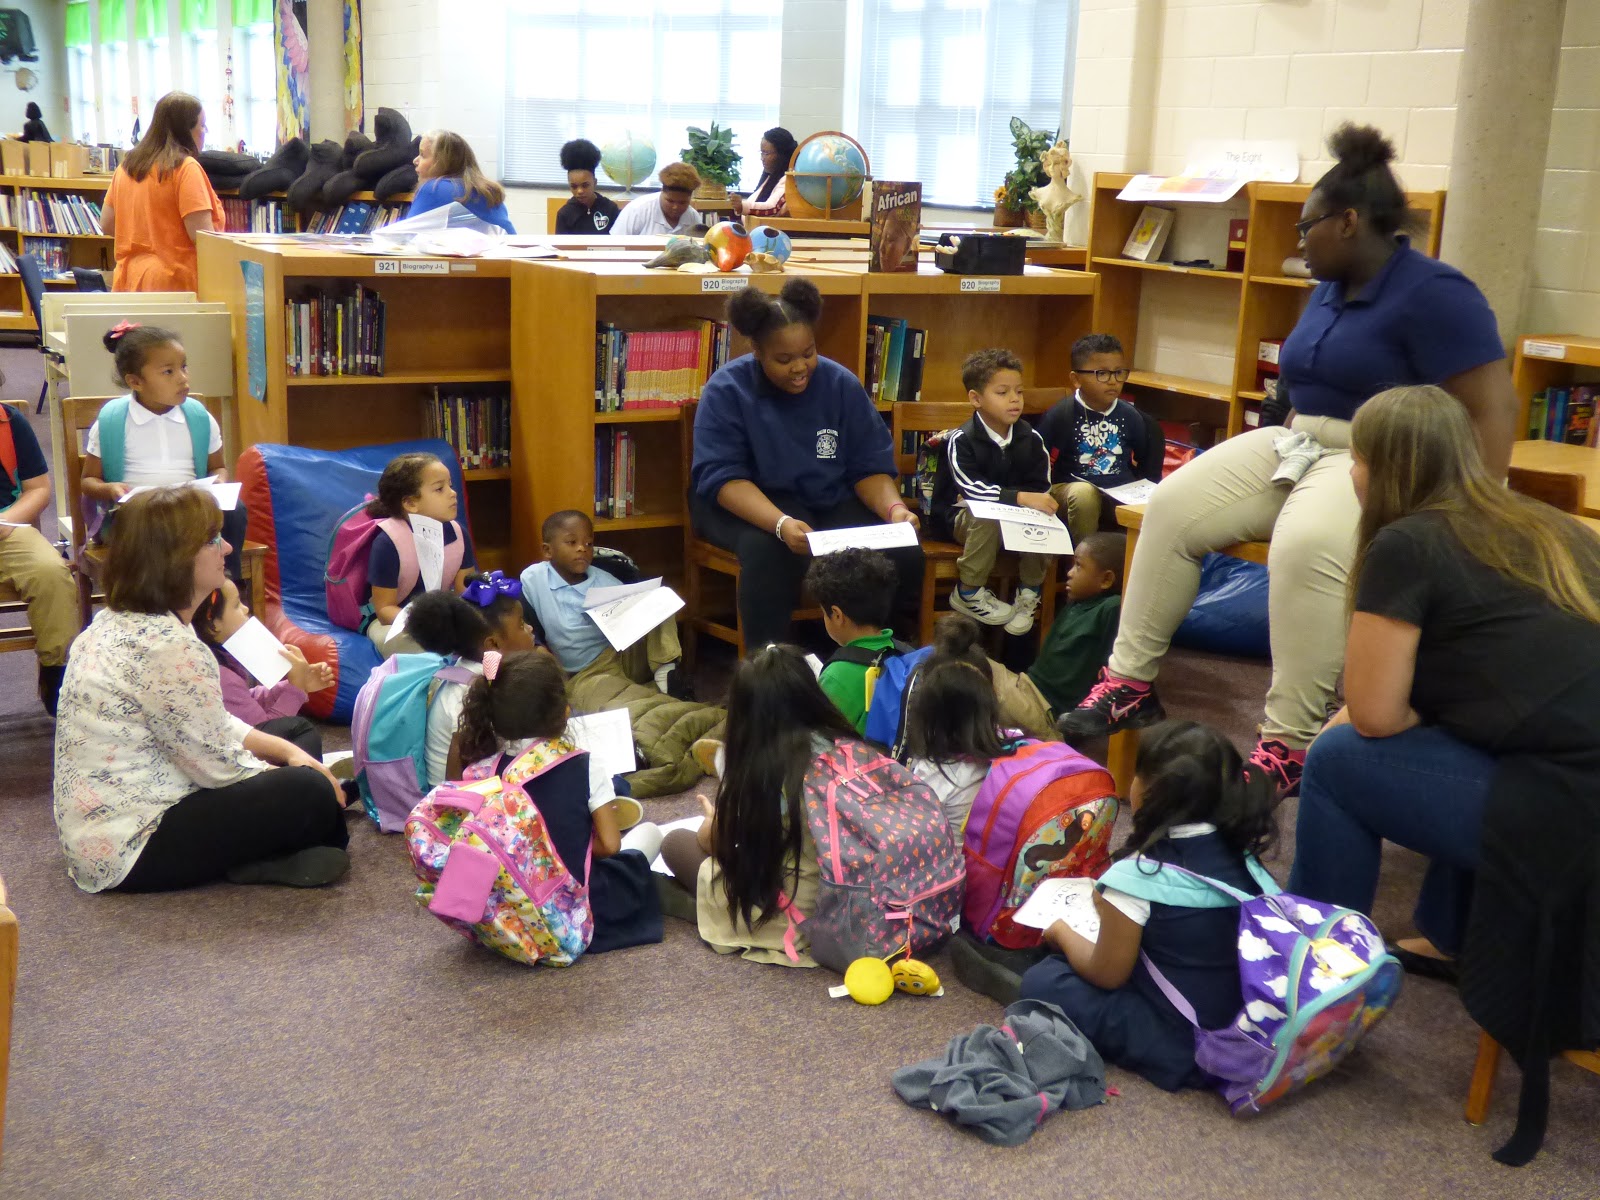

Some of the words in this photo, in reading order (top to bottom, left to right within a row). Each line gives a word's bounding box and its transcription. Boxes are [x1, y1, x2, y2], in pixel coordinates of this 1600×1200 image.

[1226, 152, 1240, 162] The
[878, 190, 918, 212] African
[378, 262, 396, 271] 921
[703, 280, 720, 290] 920
[961, 281, 976, 290] 920
[1081, 421, 1118, 436] SNOW
[1086, 432, 1108, 446] DAY
